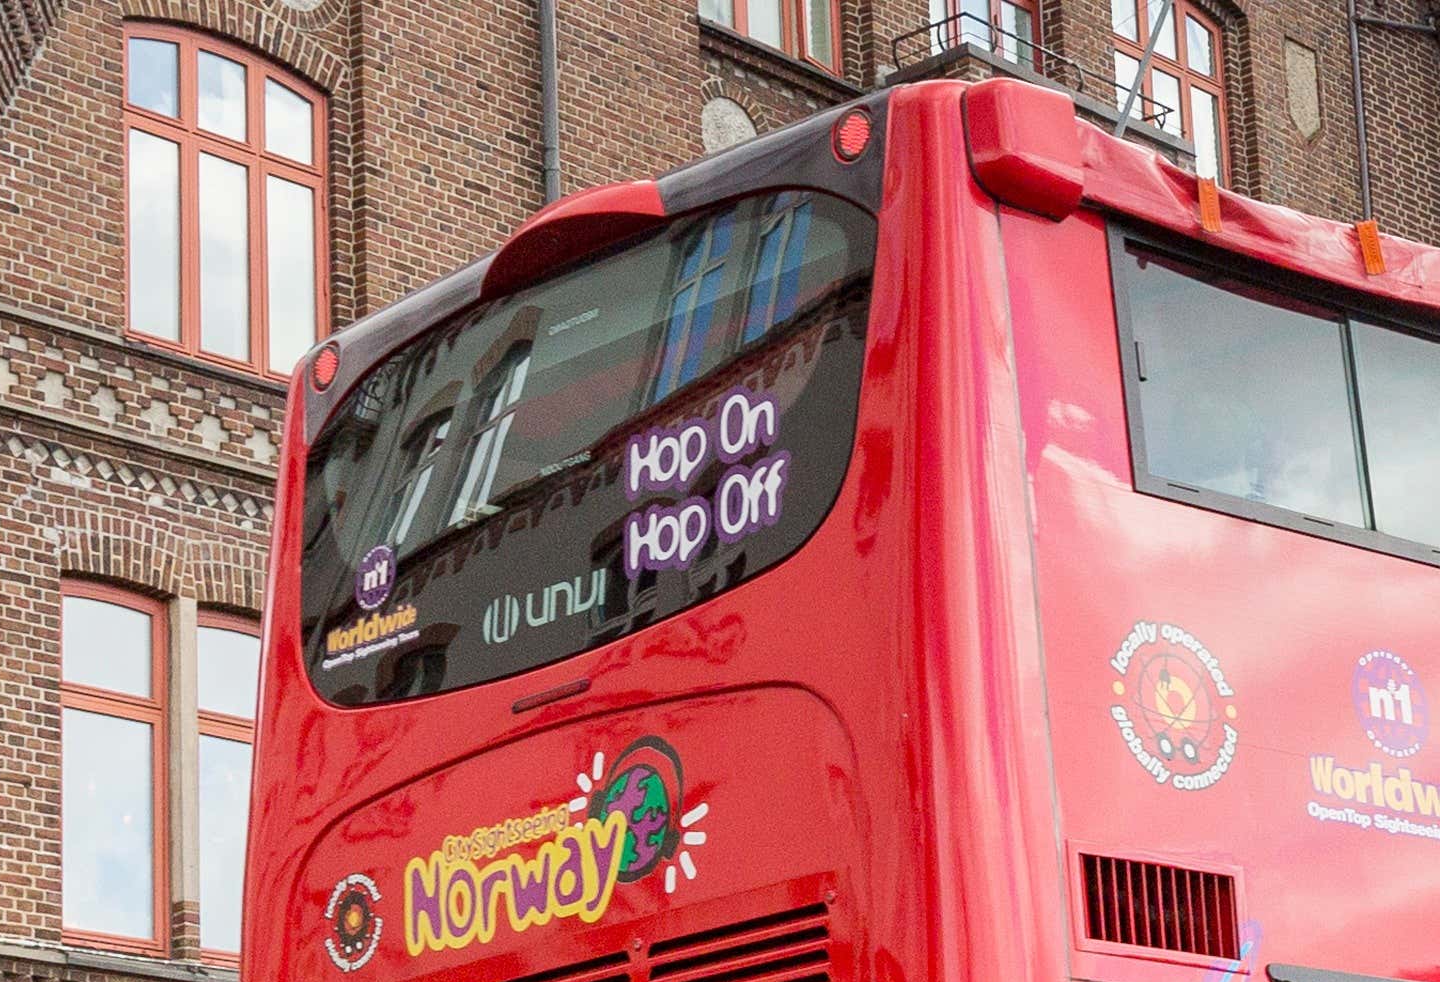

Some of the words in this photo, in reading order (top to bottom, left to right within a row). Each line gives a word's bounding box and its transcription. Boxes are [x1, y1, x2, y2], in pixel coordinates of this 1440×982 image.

[630, 426, 707, 492] Hop
[720, 394, 774, 454] On
[630, 505, 707, 570] Hop
[720, 459, 784, 534] Off
[1110, 621, 1157, 675] locally
[1161, 623, 1235, 696] operated
[1110, 704, 1171, 784] globally
[1172, 722, 1238, 790] connected
[405, 811, 626, 956] Norway
